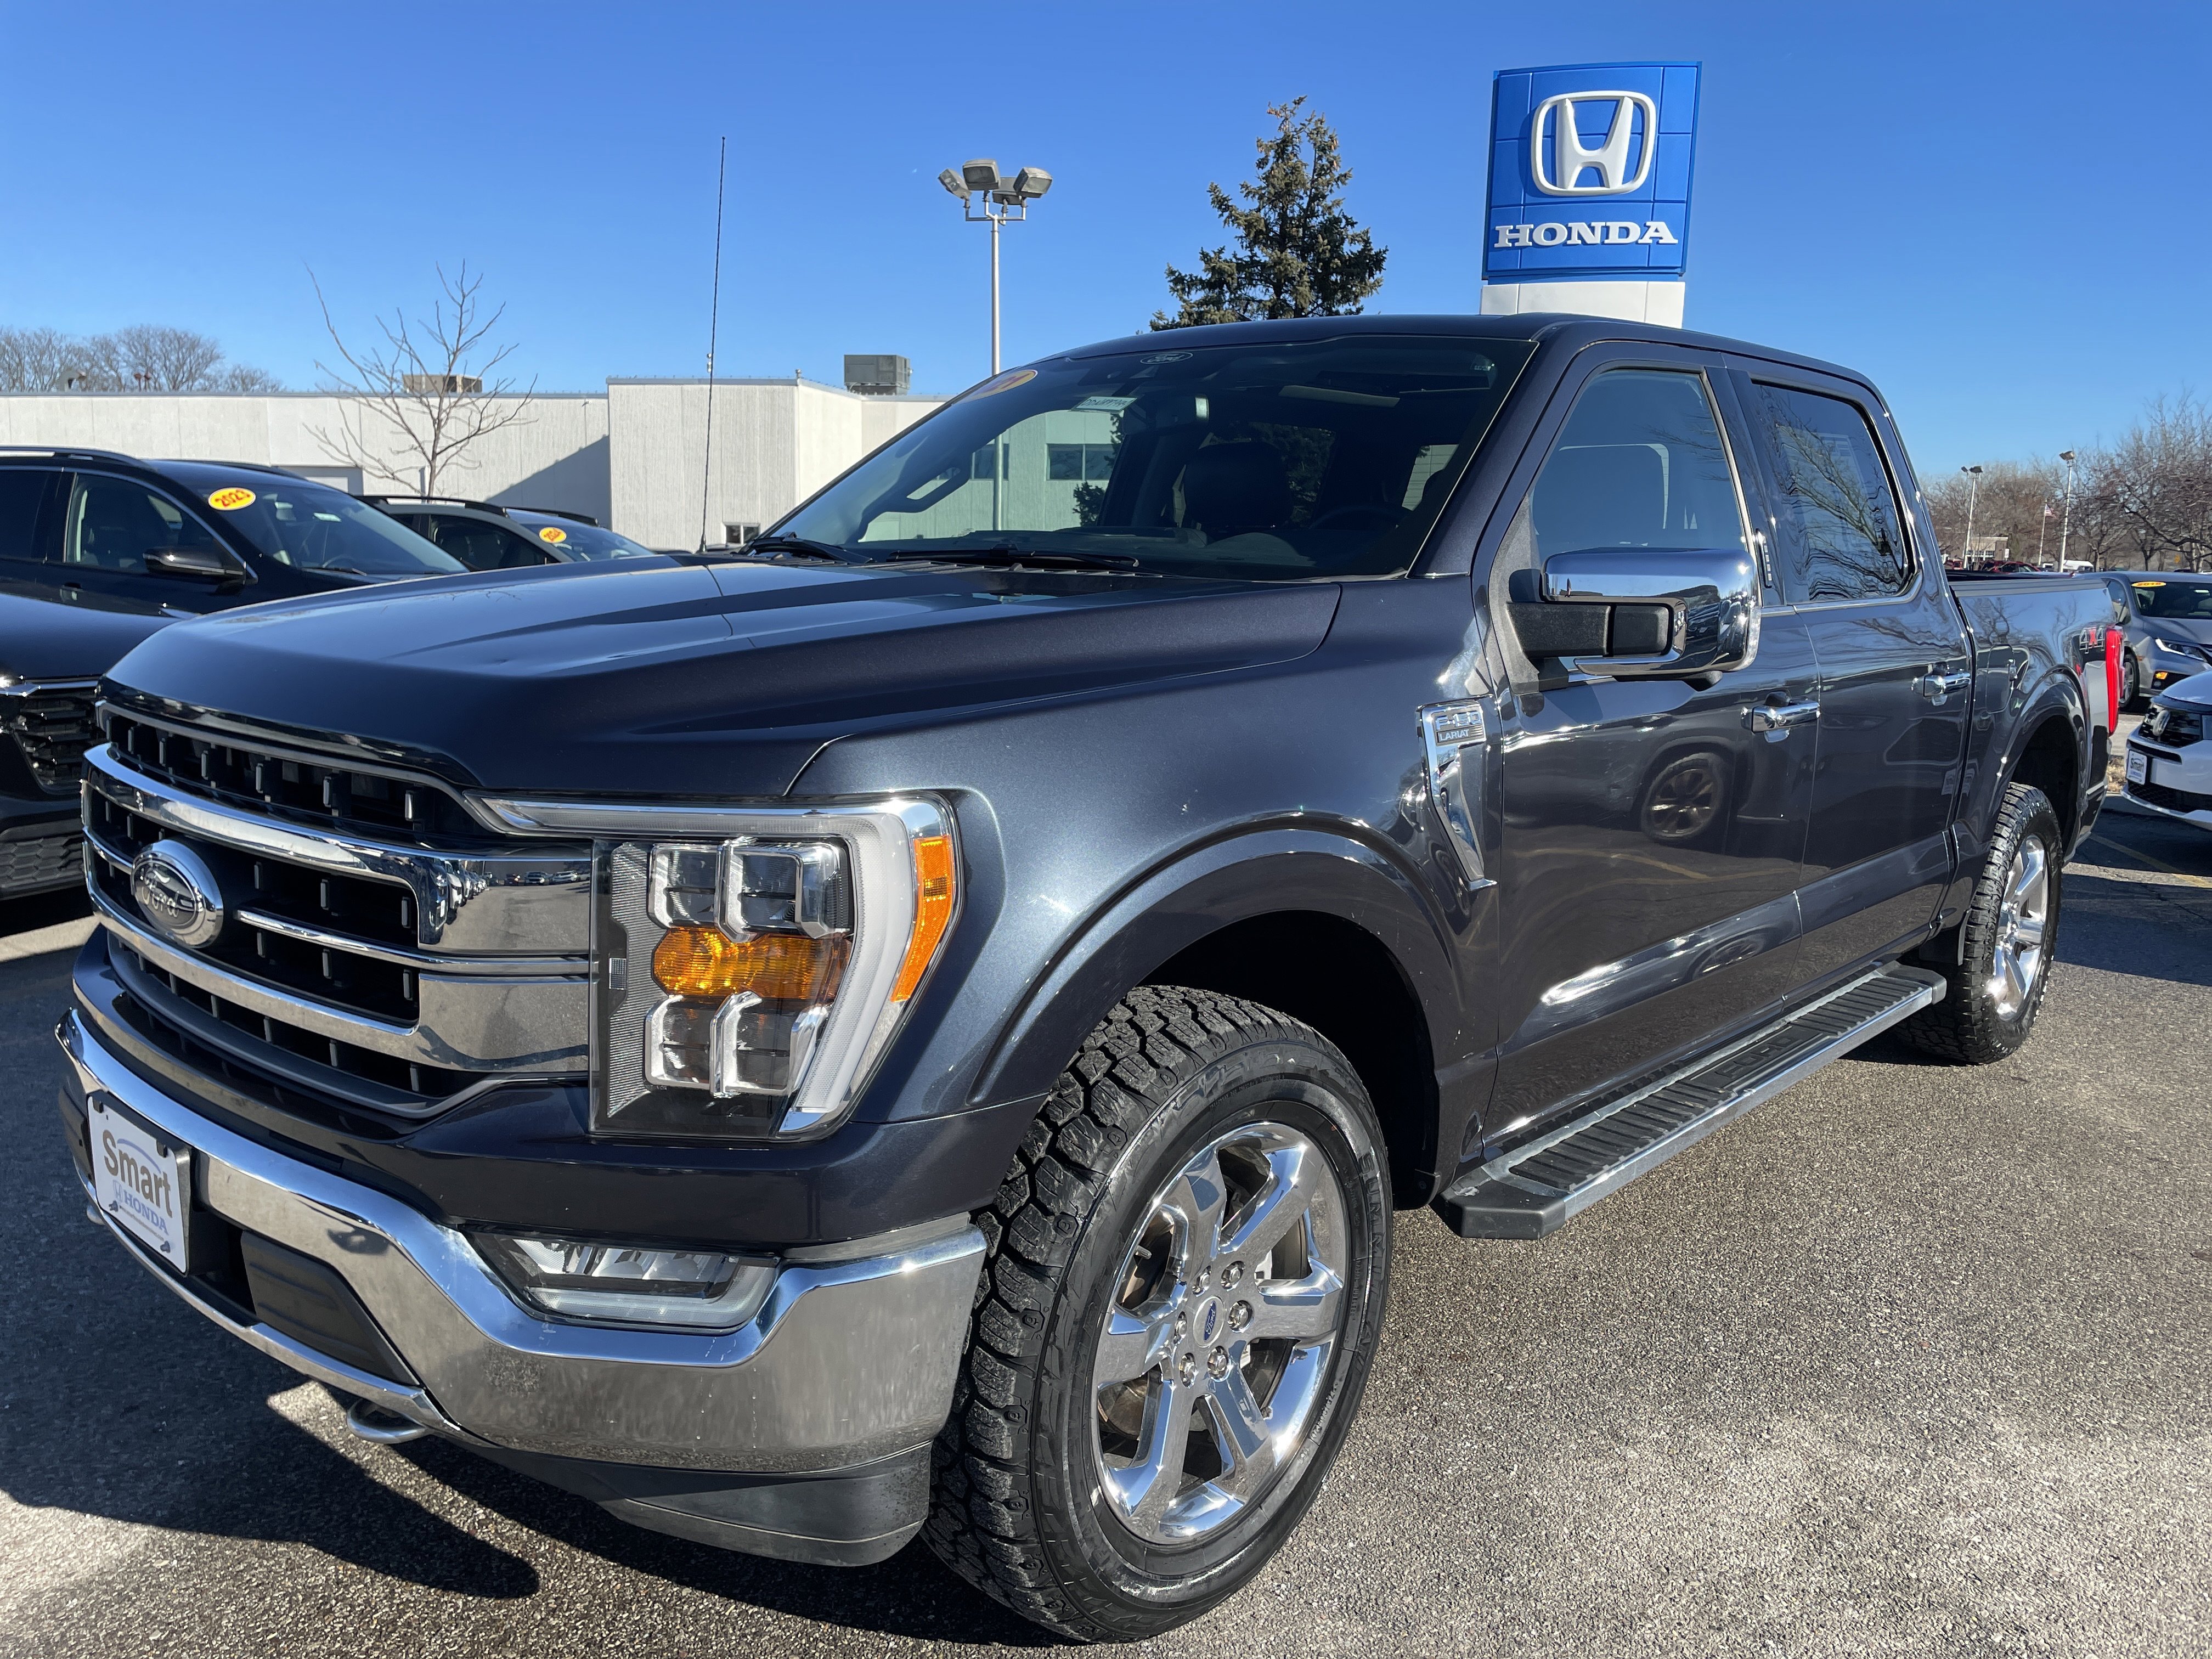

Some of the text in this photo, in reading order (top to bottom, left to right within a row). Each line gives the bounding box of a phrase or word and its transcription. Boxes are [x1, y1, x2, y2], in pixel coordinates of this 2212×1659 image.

[1494, 221, 1679, 249] HONDA
[215, 489, 251, 507] 2023
[1435, 711, 1481, 731] F-150
[1438, 729, 1470, 741] LARIAT
[102, 1130, 173, 1218] Smart
[123, 1190, 169, 1236] HONDA
[1206, 1309, 1216, 1335] Ford
